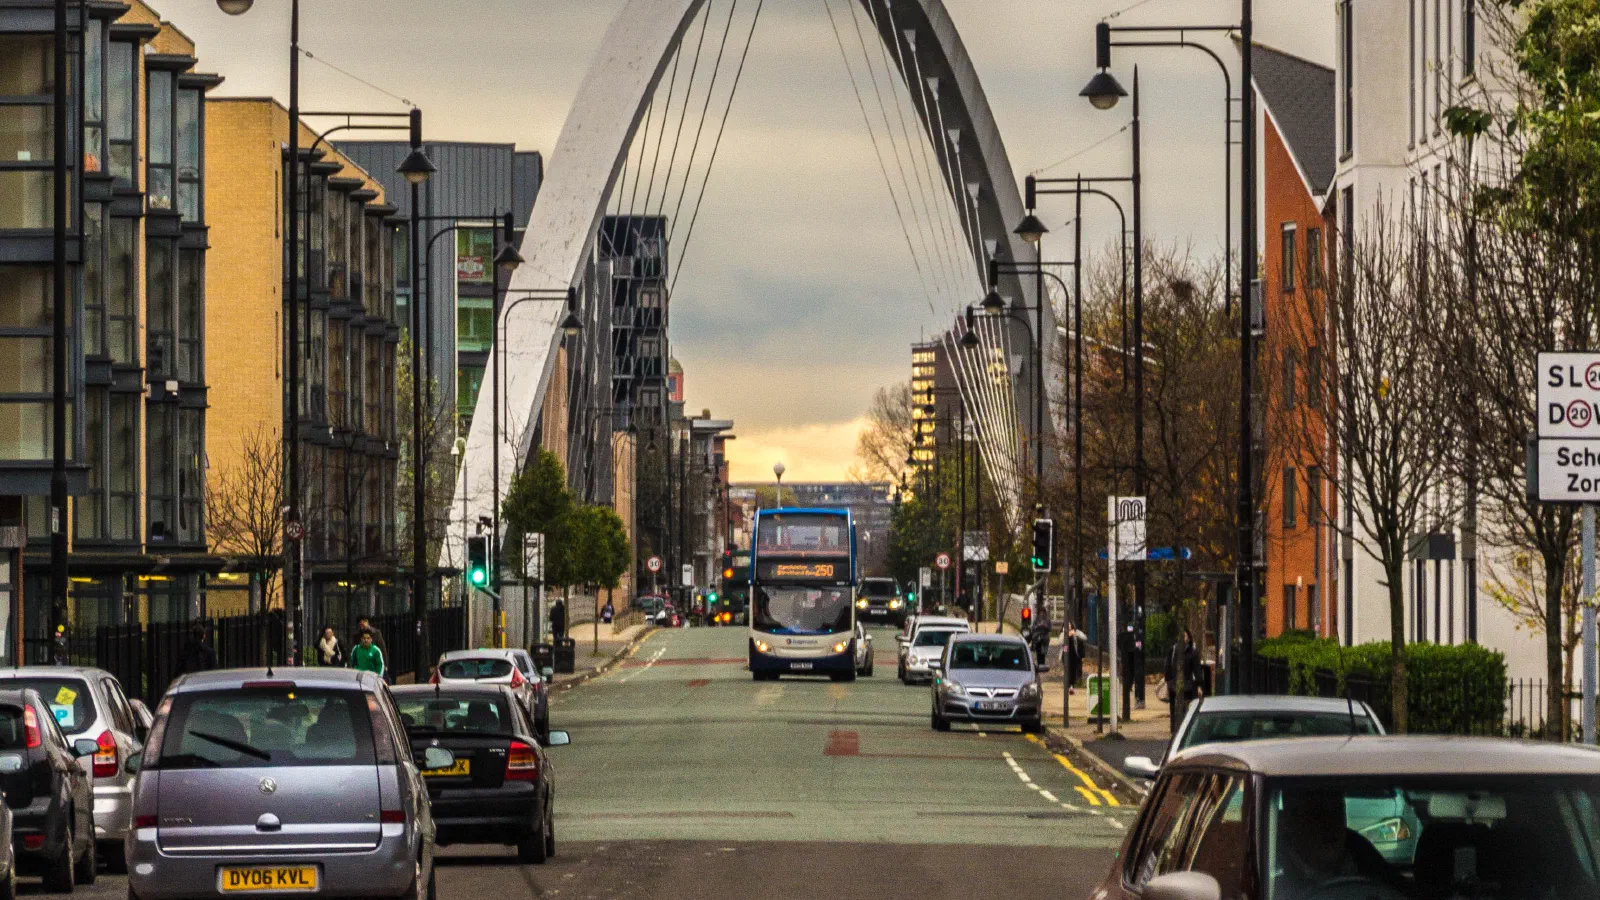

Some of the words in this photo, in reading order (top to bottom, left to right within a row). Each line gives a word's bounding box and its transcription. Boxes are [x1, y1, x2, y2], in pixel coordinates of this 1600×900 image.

[1557, 446, 1600, 467] Sch
[814, 564, 834, 577] 250
[230, 869, 273, 886] DY06
[277, 868, 309, 885] KVL
